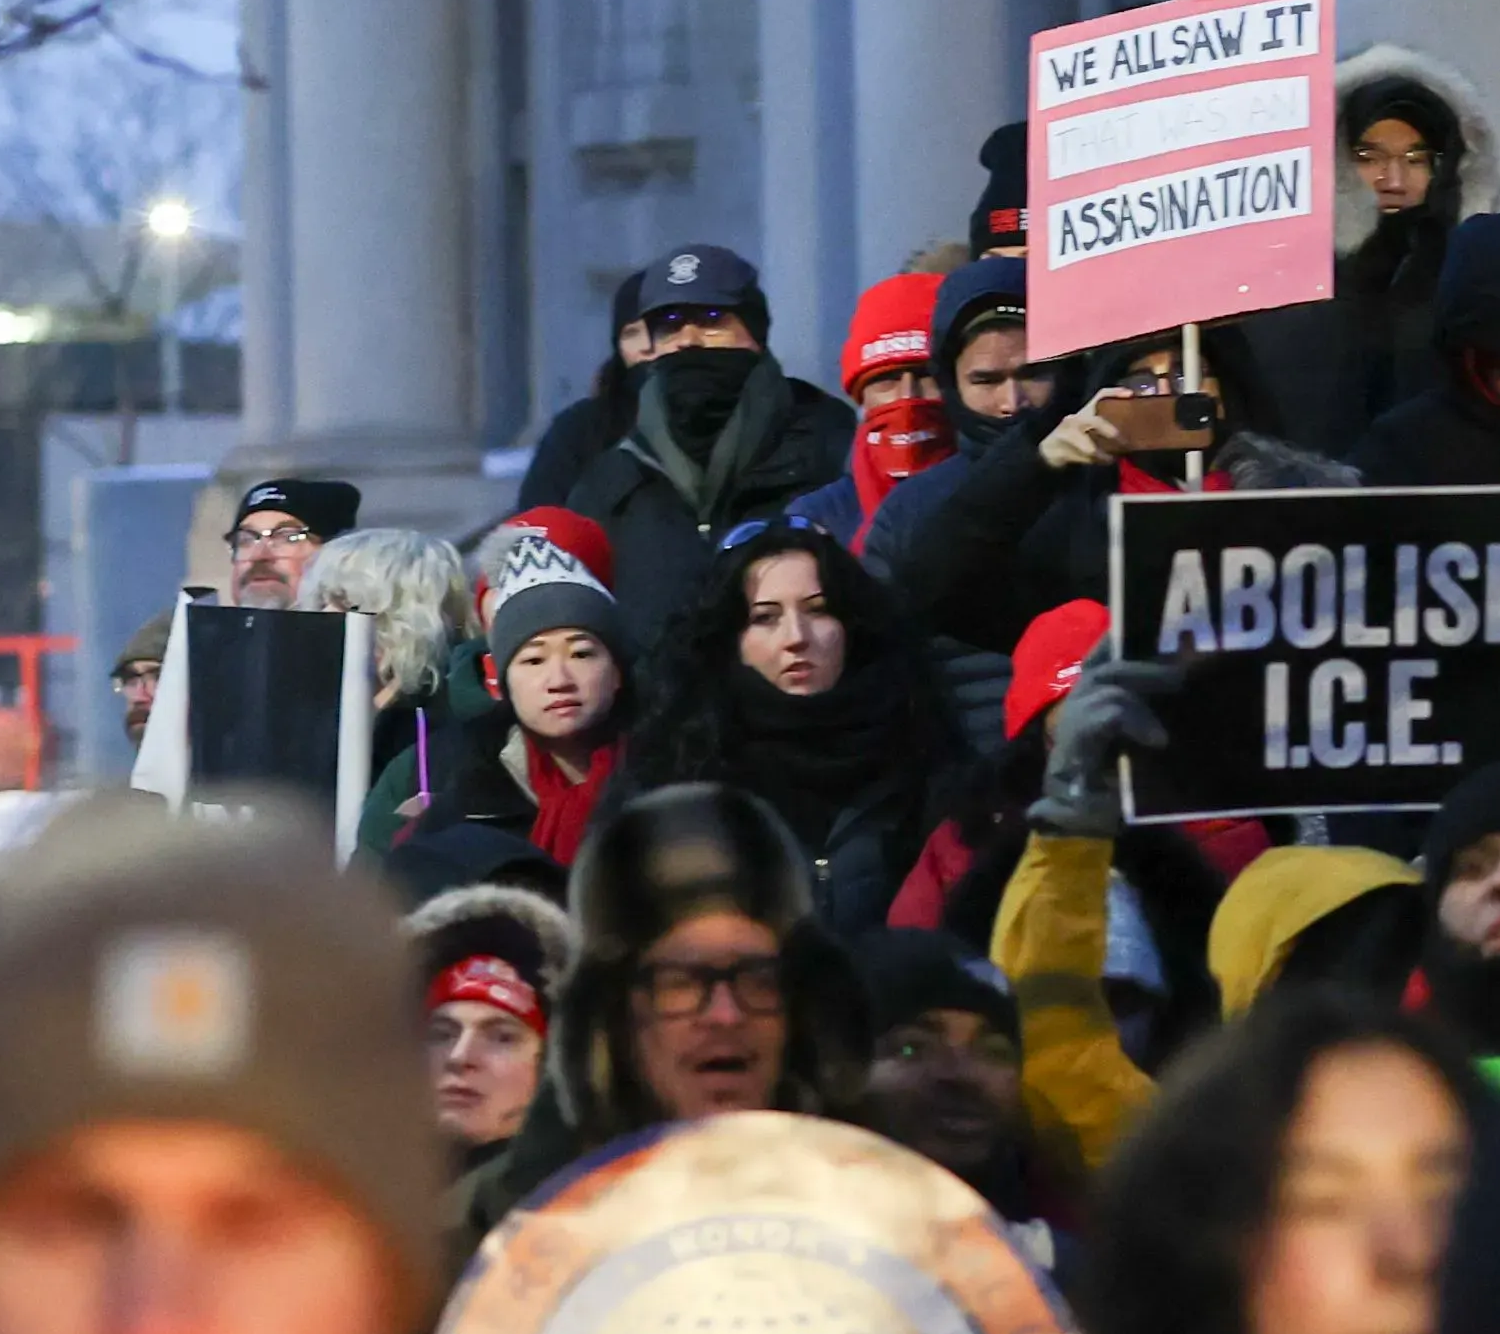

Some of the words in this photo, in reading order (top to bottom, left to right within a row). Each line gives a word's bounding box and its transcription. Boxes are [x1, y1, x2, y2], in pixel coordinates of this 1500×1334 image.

[1050, 46, 1098, 92] WE
[1261, 2, 1312, 52] IT
[1058, 159, 1300, 256] ASSASINATION
[1263, 657, 1463, 772] I.C.E.
